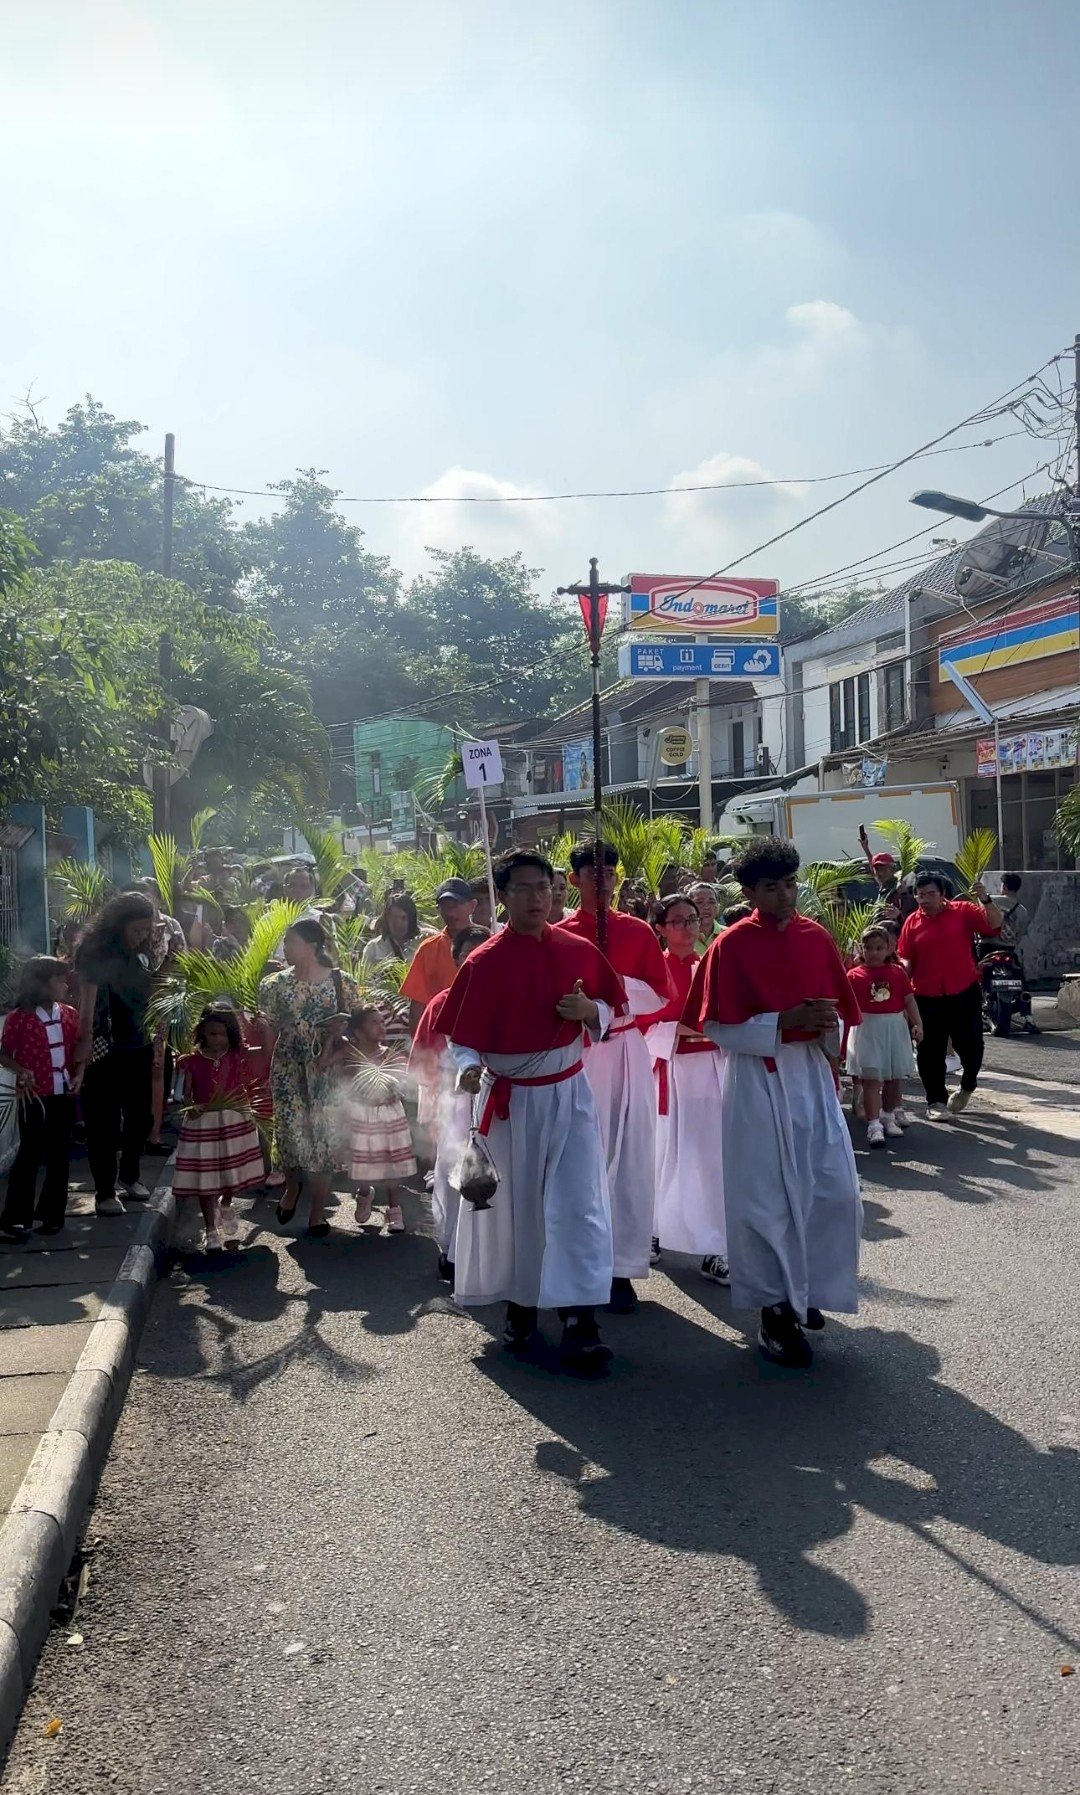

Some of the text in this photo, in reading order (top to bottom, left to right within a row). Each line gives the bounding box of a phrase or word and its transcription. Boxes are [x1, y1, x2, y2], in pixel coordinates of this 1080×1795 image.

[673, 664, 703, 672] payment
[469, 747, 492, 759] ZONA
[479, 763, 487, 781] 1
